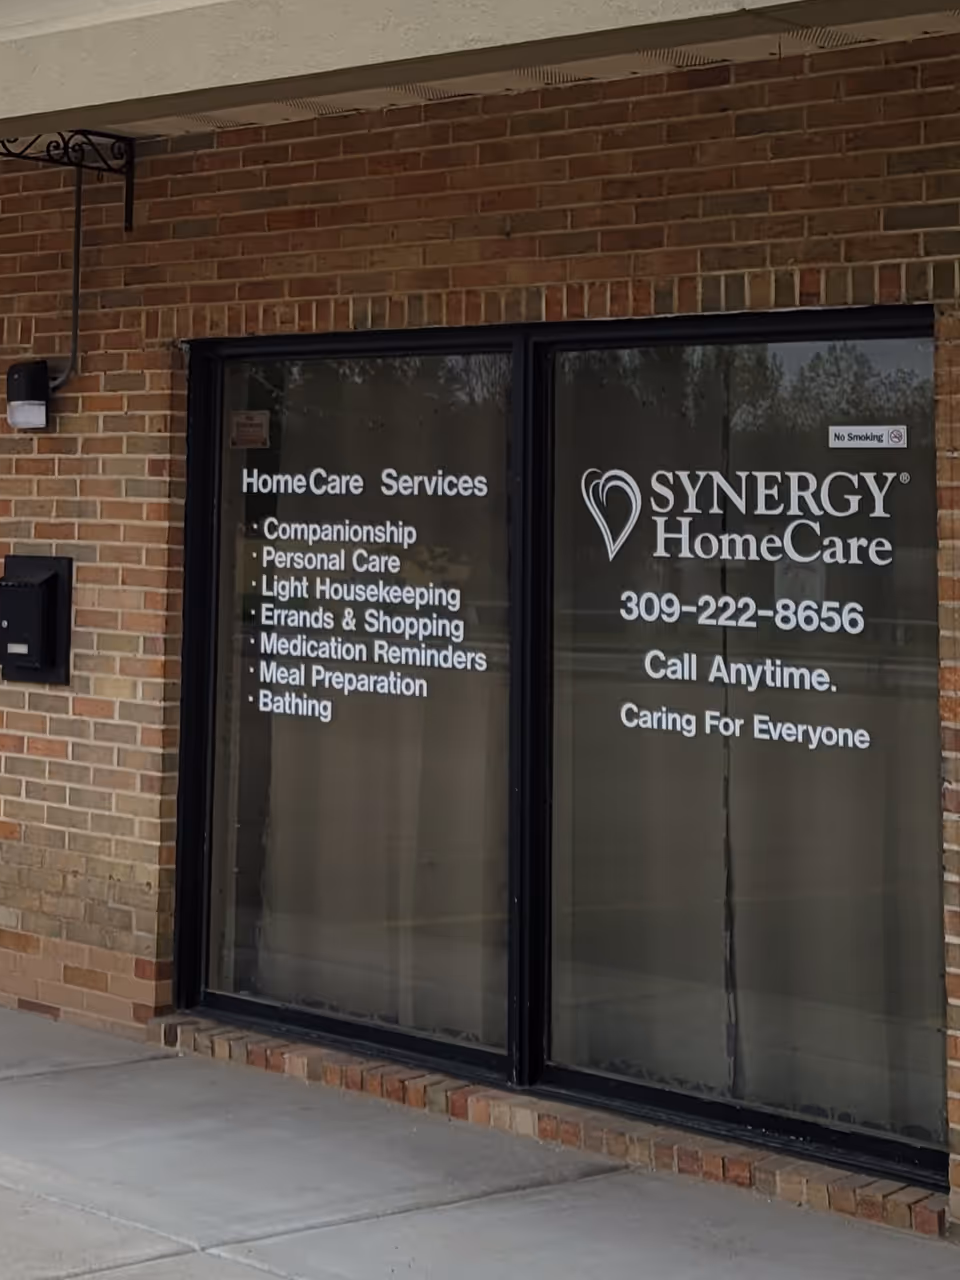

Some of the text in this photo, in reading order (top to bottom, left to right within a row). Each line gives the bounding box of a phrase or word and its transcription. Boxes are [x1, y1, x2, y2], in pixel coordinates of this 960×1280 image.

[833, 431, 884, 444] No Smoking
[380, 468, 489, 497] Services
[263, 517, 417, 549] Companionship
[652, 516, 893, 566] HomeCare
[262, 546, 401, 574] Personal Care
[261, 574, 461, 611] Light Housekeeping
[260, 603, 465, 643] Errands & Shopping
[619, 590, 865, 635] 309-222-8656
[259, 631, 488, 671] Medication Reminders
[259, 660, 428, 698] Meal Preparation
[644, 649, 838, 693] Call Anytime.
[258, 689, 333, 723] Bathing
[620, 702, 871, 750] Caring For Everyone
